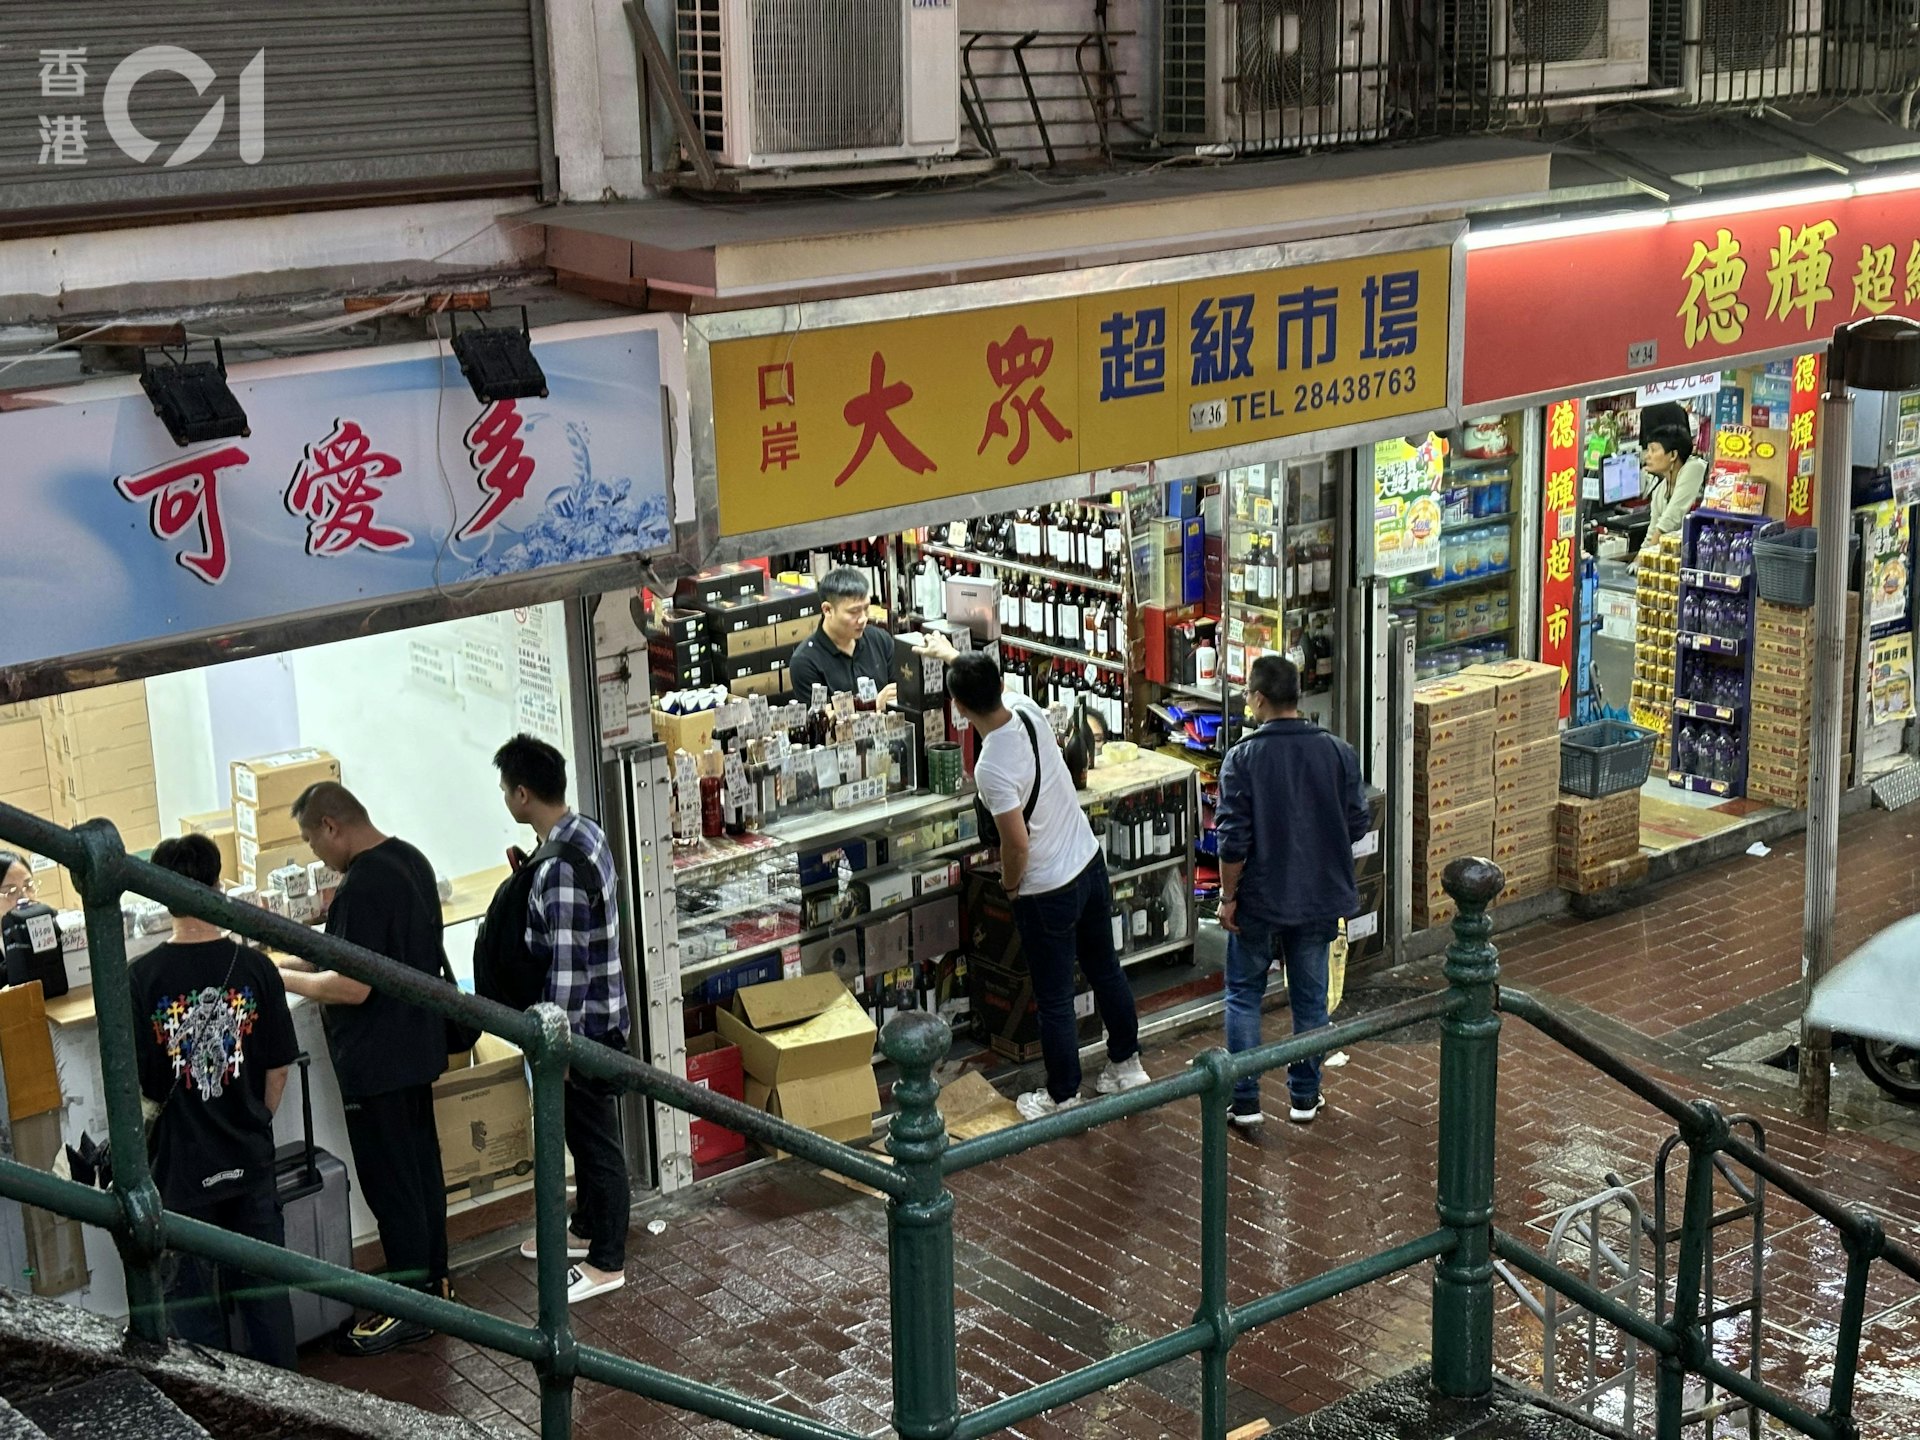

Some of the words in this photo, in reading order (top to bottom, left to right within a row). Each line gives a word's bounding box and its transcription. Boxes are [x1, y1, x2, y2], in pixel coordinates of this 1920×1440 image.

[1099, 269, 1420, 403] 超級市場
[1677, 219, 1838, 350] 德輝
[757, 361, 801, 474] 口岸
[1207, 404, 1223, 426] 36
[1231, 389, 1285, 424] TEL
[1294, 366, 1417, 412] 28438763
[114, 398, 538, 586] 可愛多
[1545, 399, 1578, 650] 德輝超市
